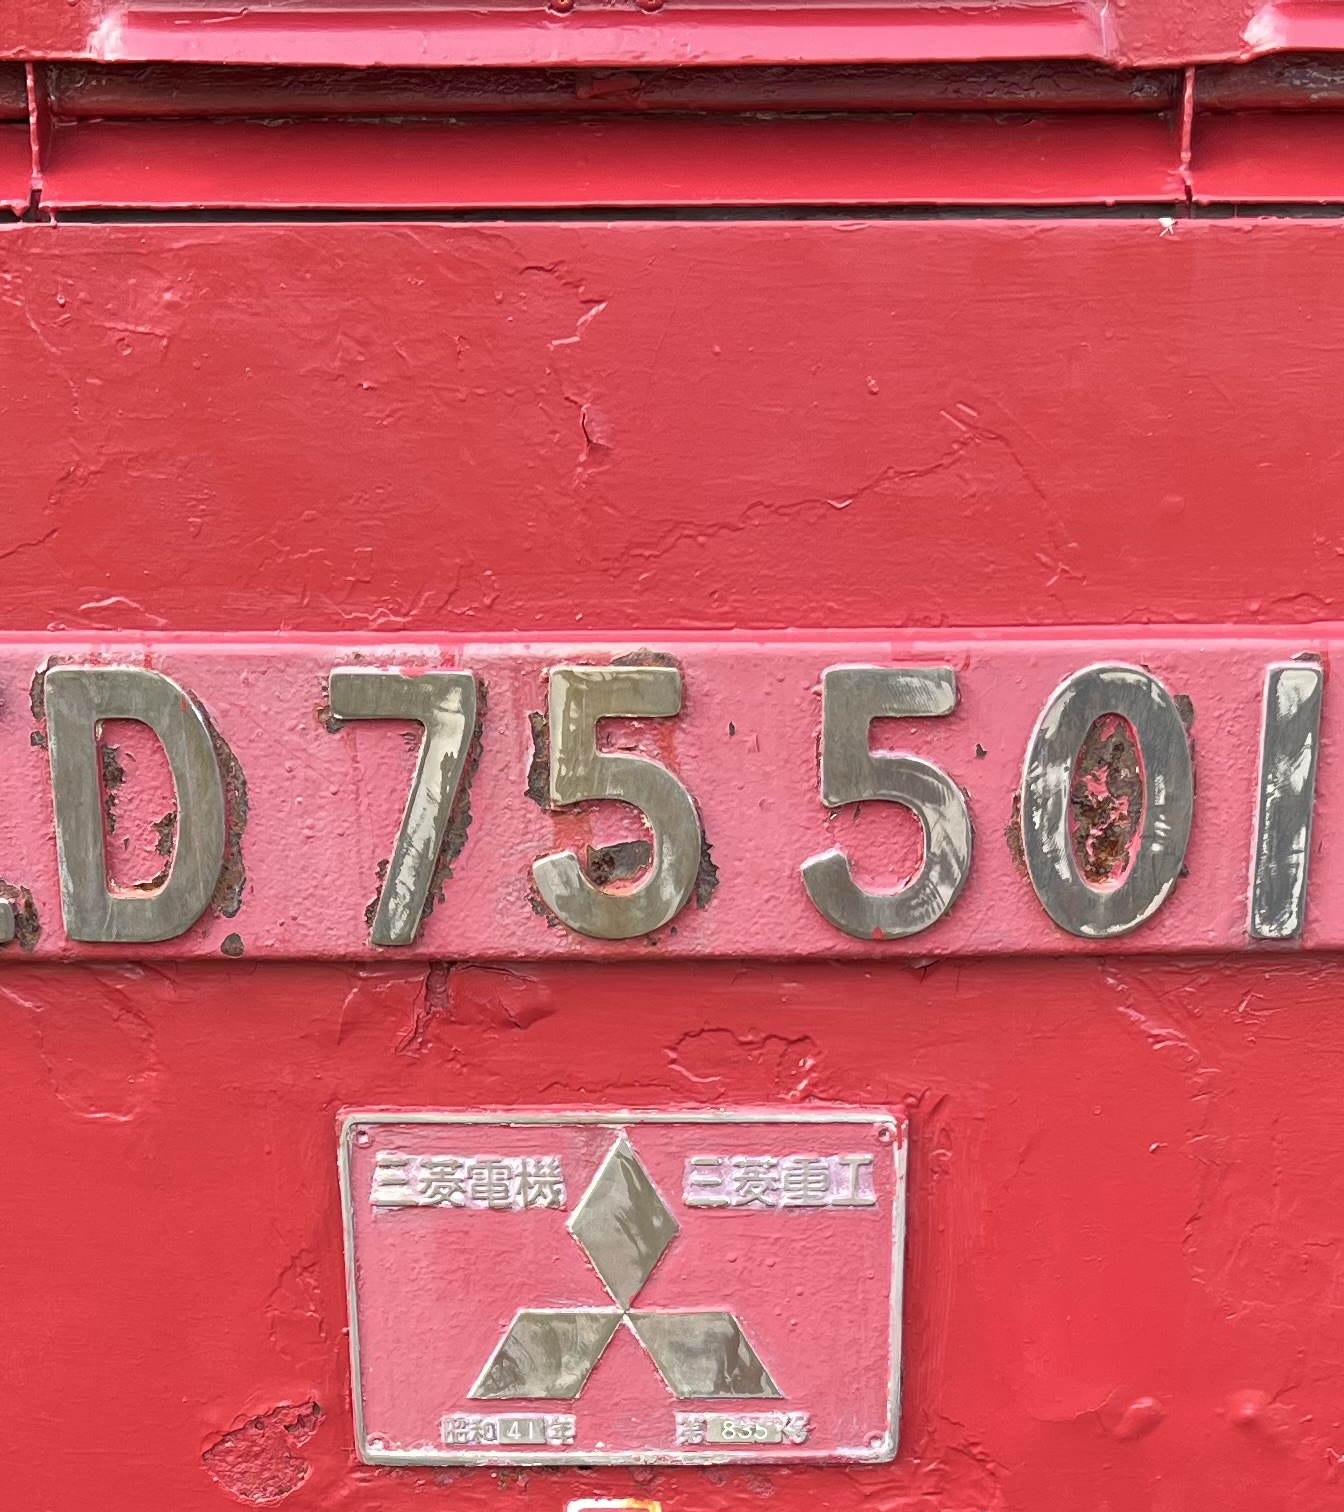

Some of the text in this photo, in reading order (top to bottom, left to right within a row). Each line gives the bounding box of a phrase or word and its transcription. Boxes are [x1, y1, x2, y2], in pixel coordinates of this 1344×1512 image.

[327, 664, 704, 945] 75
[799, 659, 1323, 942] 501
[370, 1153, 566, 1209] 三菱電機
[684, 1155, 877, 1208] 三菱重工
[443, 1414, 575, 1444] 昭和41年
